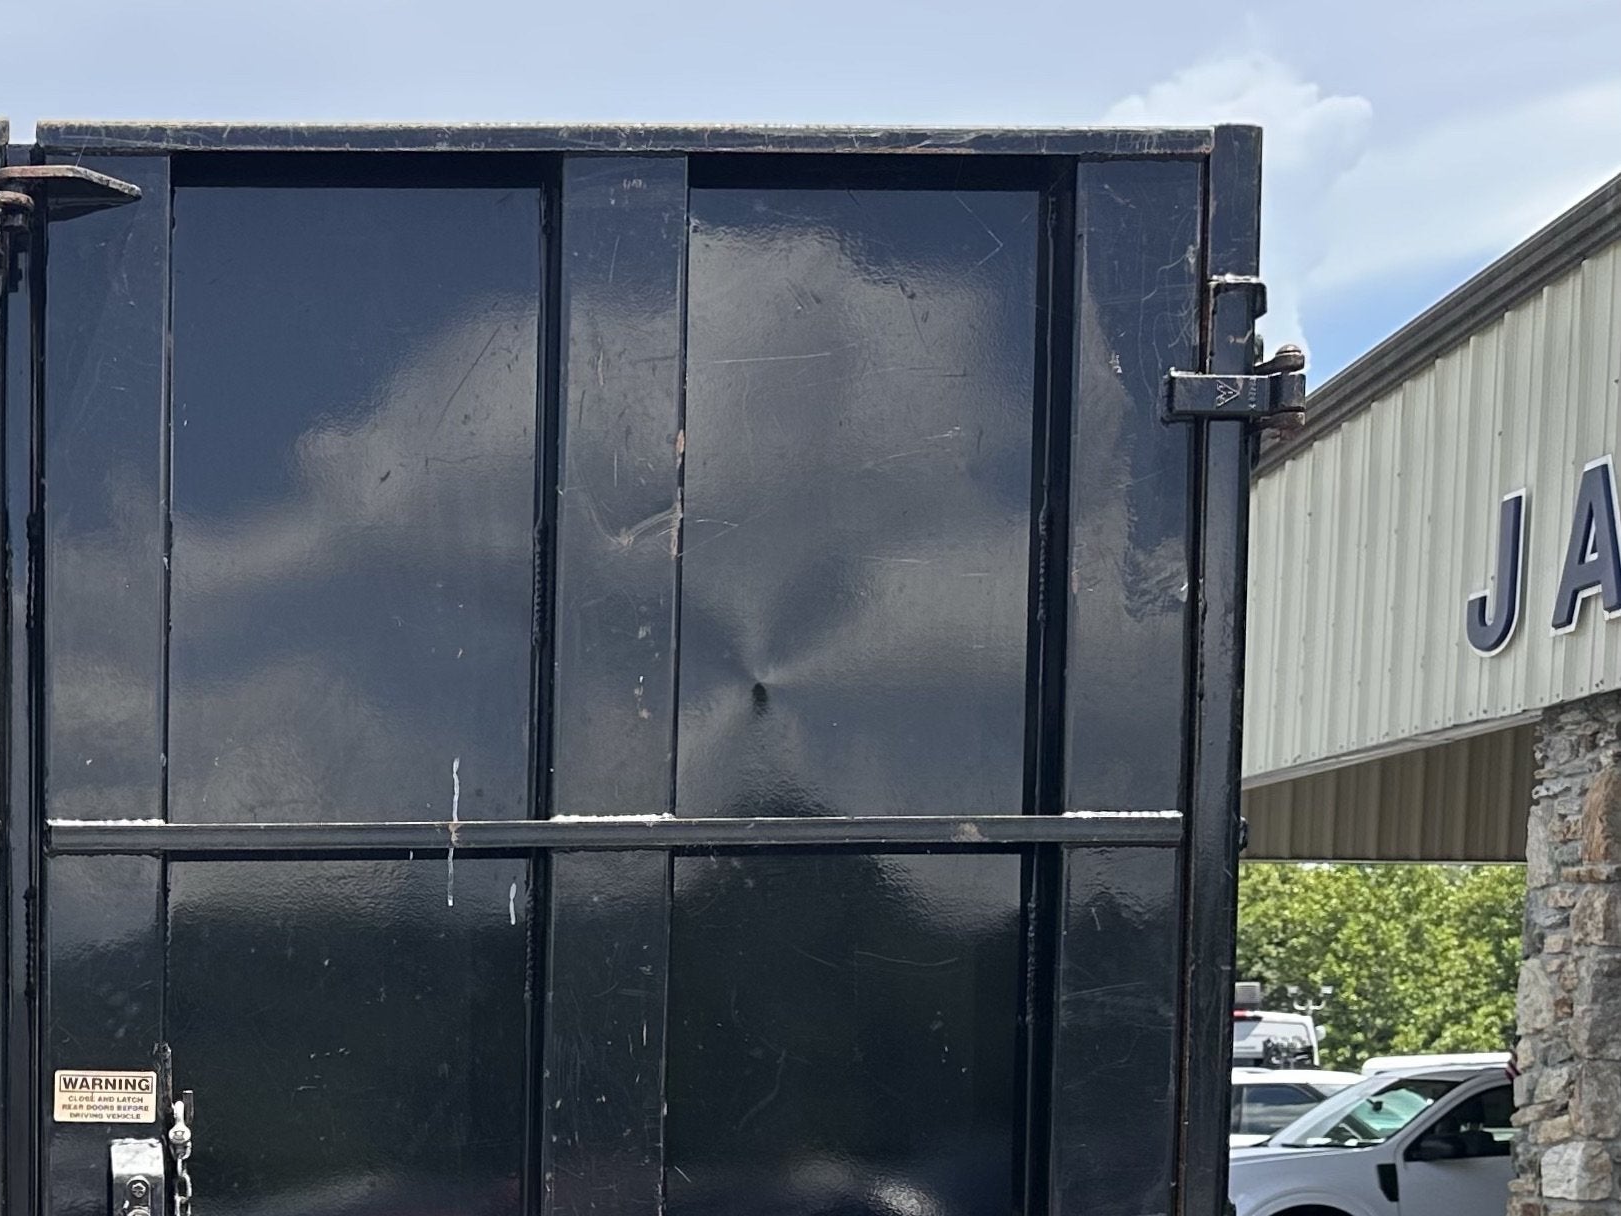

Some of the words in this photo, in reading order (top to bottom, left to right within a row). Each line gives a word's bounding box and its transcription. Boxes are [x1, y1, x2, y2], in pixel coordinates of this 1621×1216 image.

[1466, 454, 1621, 657] JA
[62, 1077, 150, 1091] WARNING
[68, 1095, 94, 1103] CLOSE
[116, 1096, 144, 1104] LATCH
[86, 1104, 115, 1112] DOORS
